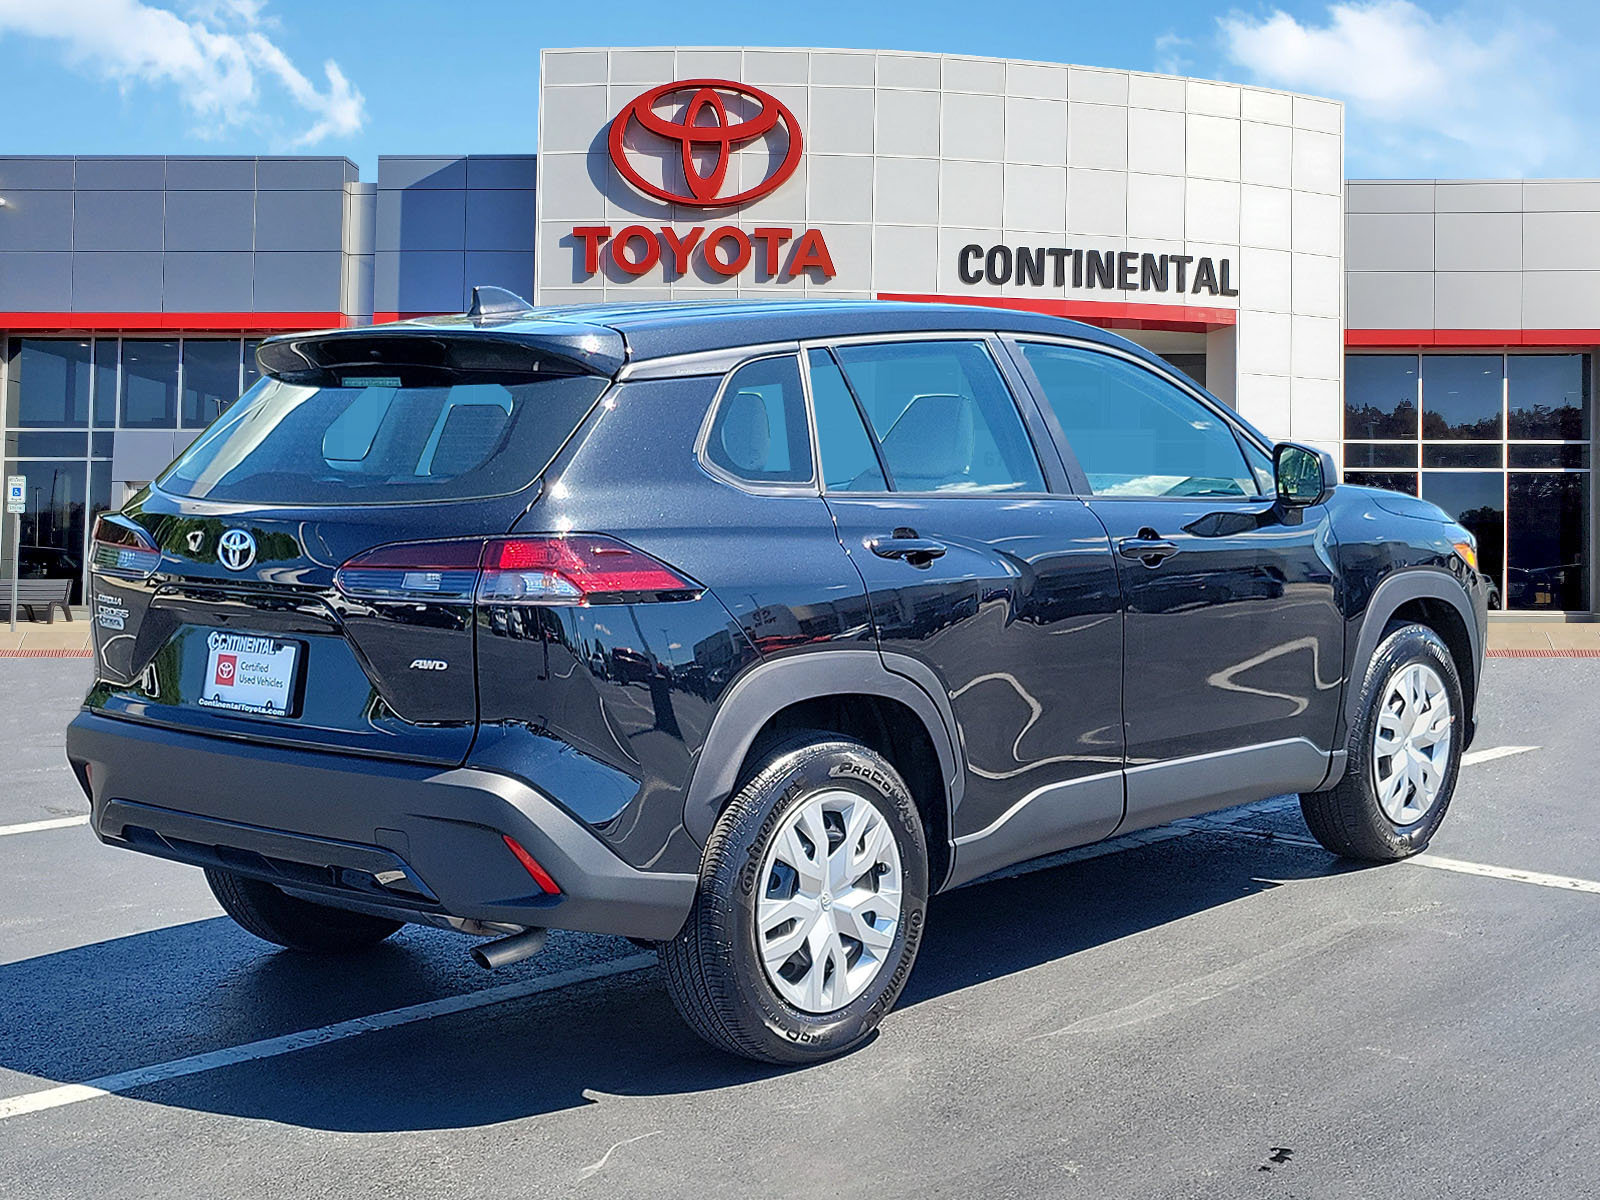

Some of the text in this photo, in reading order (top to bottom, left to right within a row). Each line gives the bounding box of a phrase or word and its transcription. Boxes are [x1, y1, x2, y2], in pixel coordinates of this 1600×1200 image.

[573, 225, 837, 277] TOYOTA
[958, 244, 1239, 297] CONTINENTAL
[98, 605, 129, 618] CROSS
[207, 631, 276, 655] CONTINENTAL
[240, 661, 269, 673] Certified
[410, 659, 448, 671] AWD
[239, 674, 283, 688] Used Vehicles
[198, 698, 285, 716] ContinentalToyota.com
